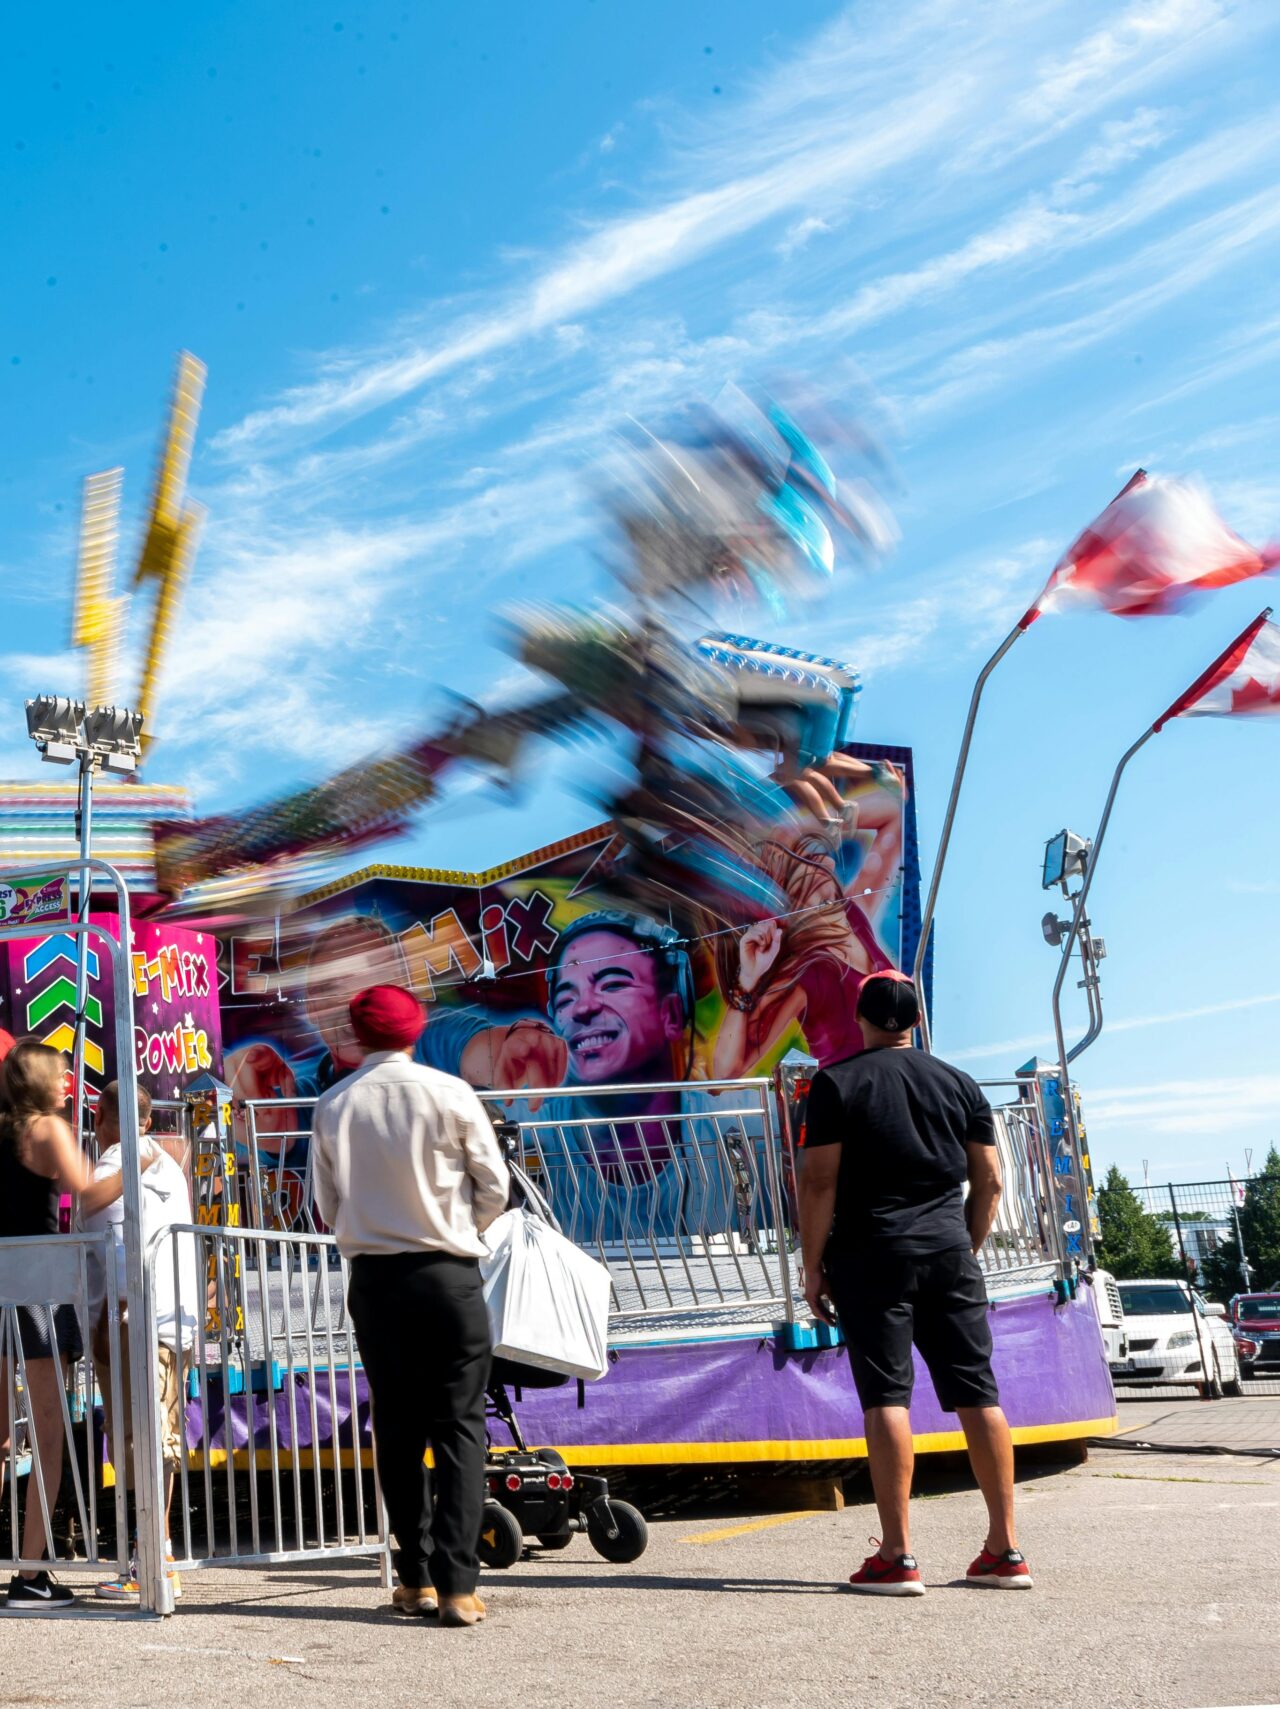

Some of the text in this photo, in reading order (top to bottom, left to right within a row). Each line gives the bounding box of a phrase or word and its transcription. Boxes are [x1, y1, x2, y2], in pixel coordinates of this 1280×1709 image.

[24, 892, 63, 911] EXPRESS
[34, 901, 60, 913] ACCESS
[218, 890, 559, 1001] E-Mix
[131, 944, 210, 1004] E-Mix
[134, 1021, 213, 1076] POWER
